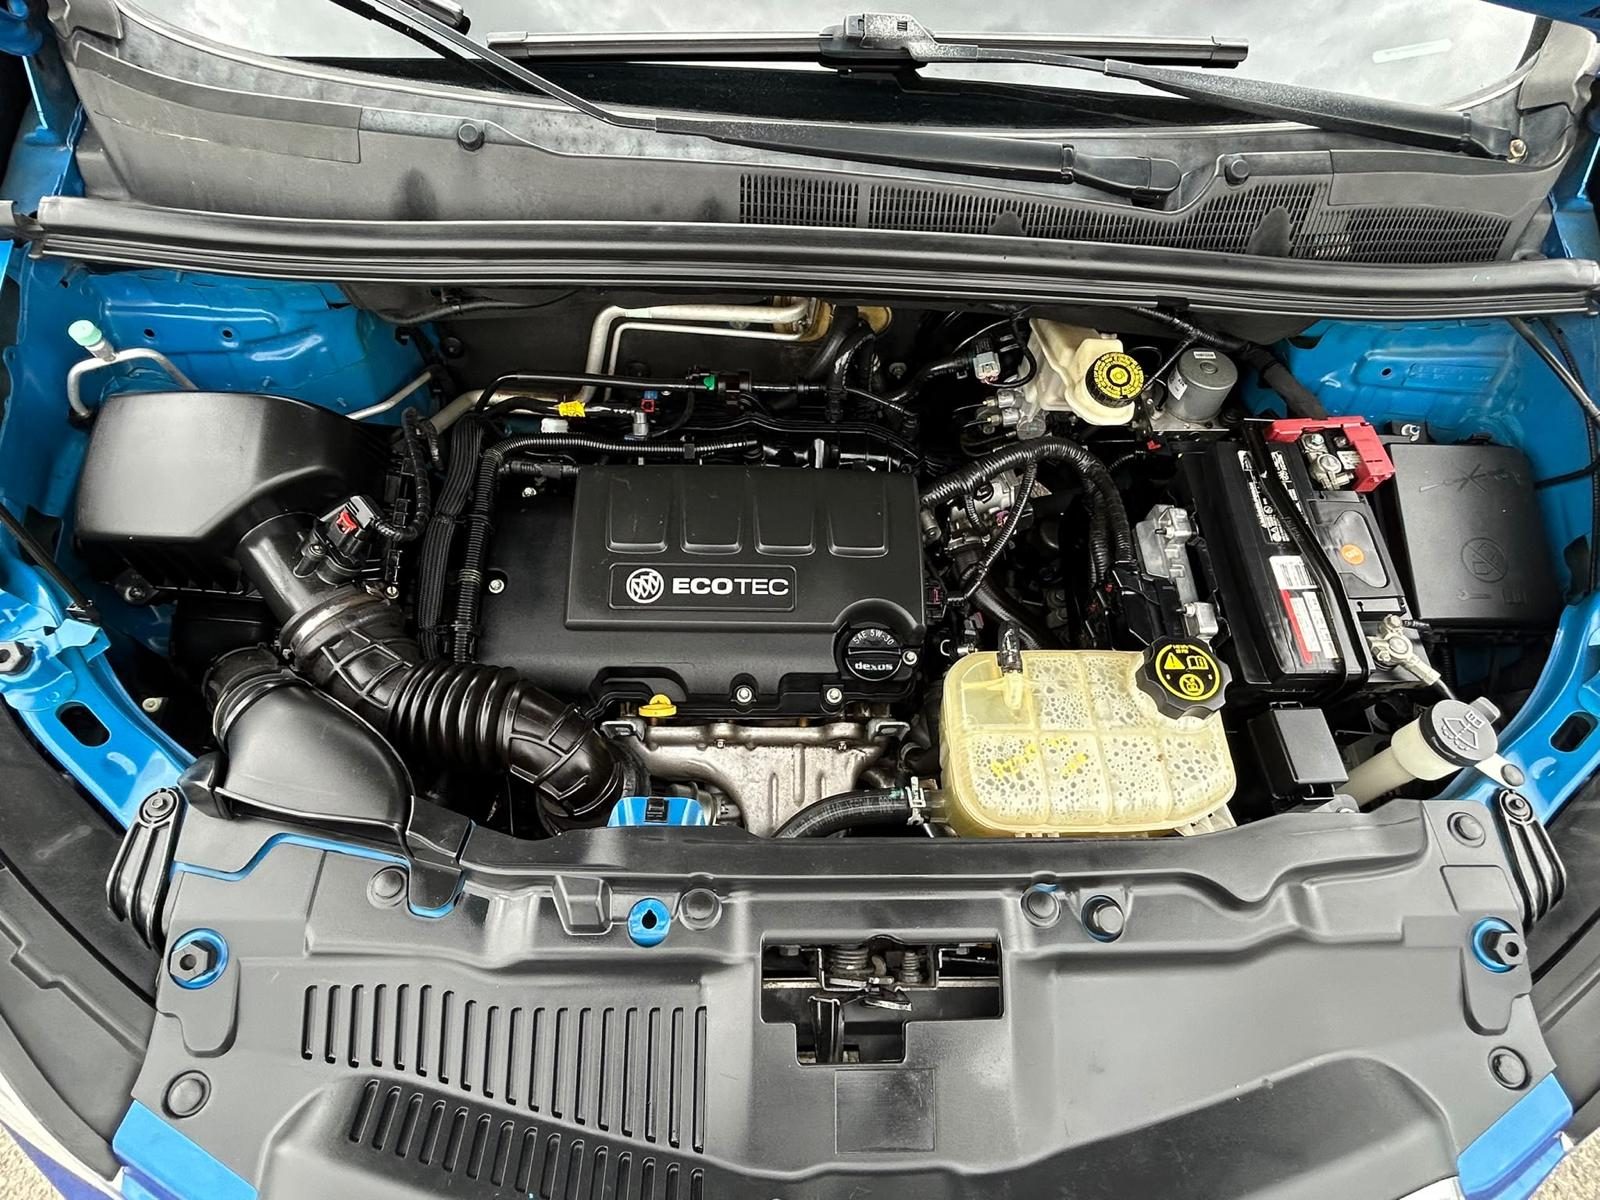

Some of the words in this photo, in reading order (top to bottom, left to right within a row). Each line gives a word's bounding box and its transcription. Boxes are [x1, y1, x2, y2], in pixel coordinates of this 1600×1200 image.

[672, 577, 789, 596] ECOTEC
[853, 630, 868, 645] SAE
[870, 629, 895, 645] 5W-30
